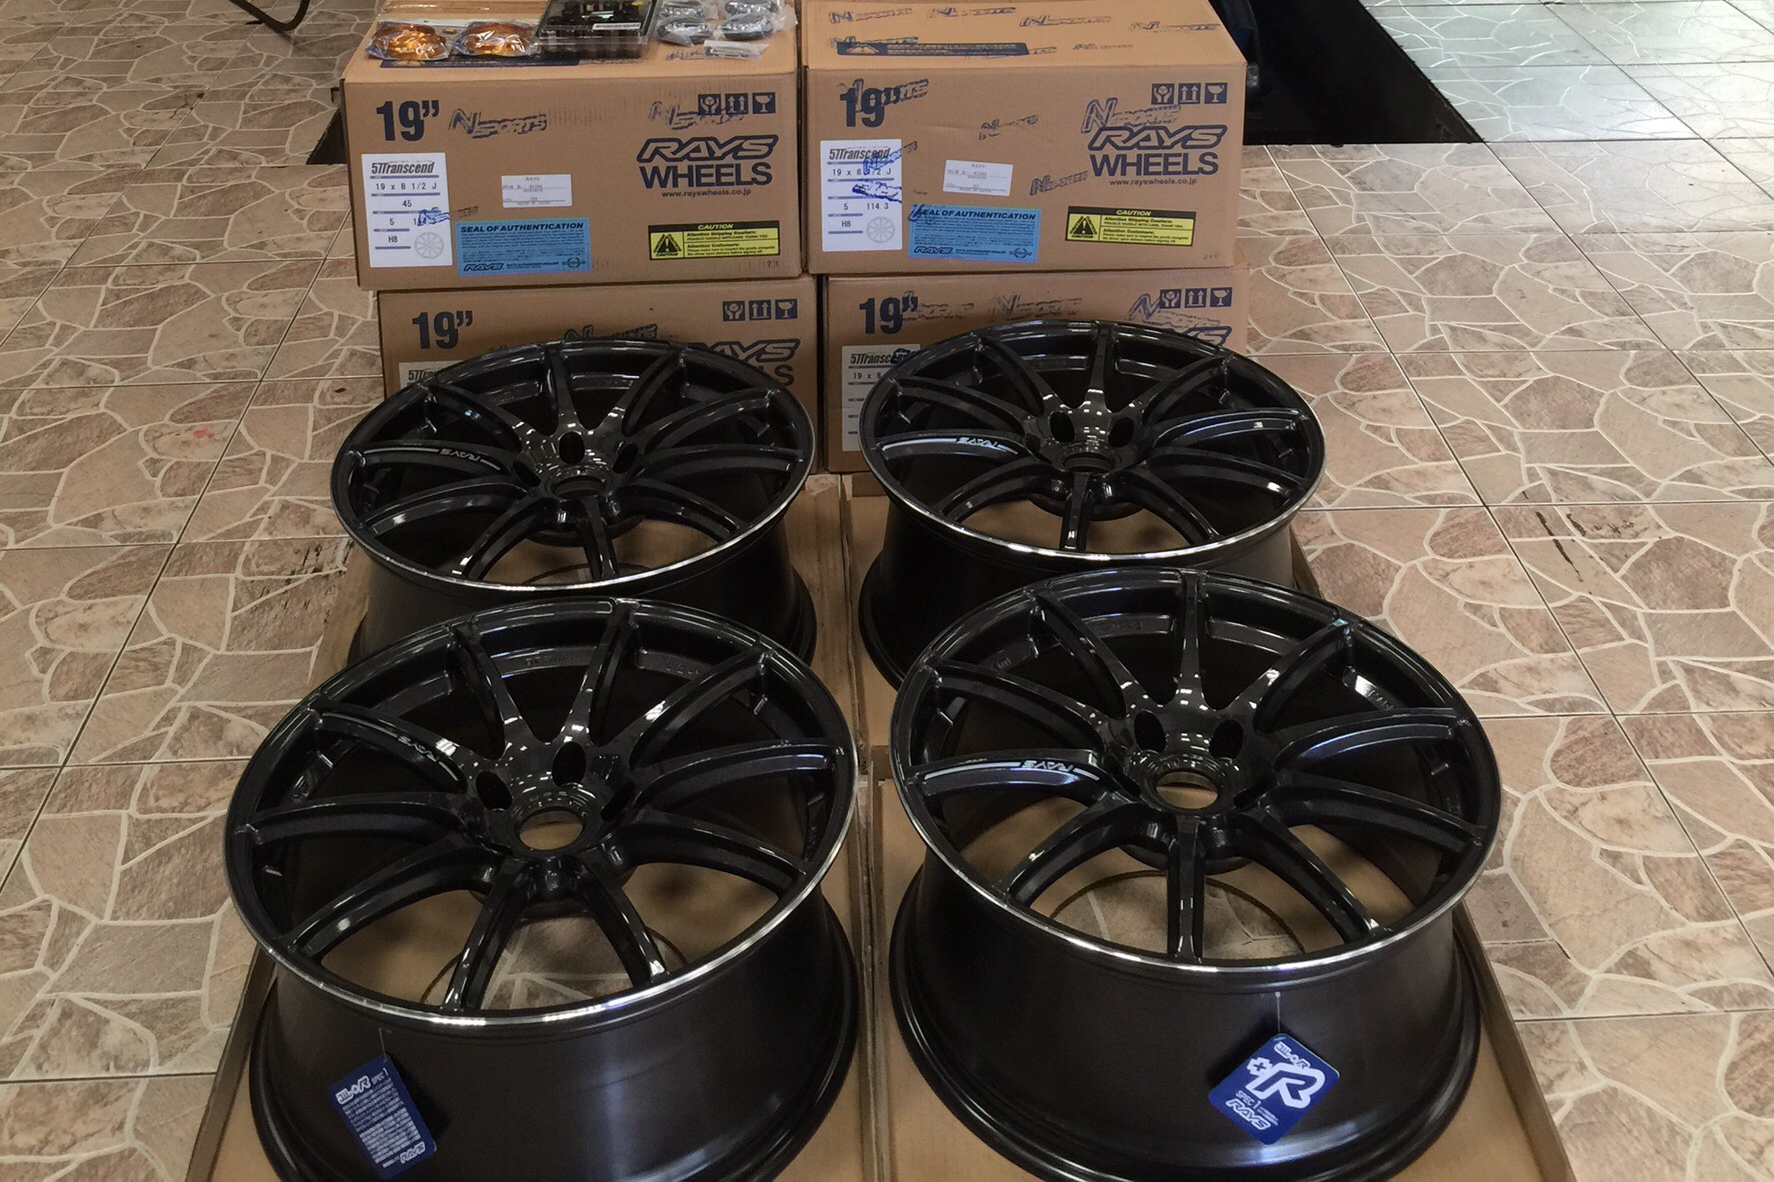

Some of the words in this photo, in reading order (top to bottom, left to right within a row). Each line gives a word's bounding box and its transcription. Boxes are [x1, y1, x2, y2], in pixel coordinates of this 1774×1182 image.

[1087, 124, 1228, 151] RAYS
[636, 134, 779, 163] RAYS
[1089, 151, 1219, 178] WHEELS
[638, 161, 773, 190] WHEELS
[832, 168, 842, 176] 19
[856, 168, 862, 176] 8
[375, 182, 386, 191] 19
[401, 182, 407, 191] 8
[411, 182, 427, 191] 1/2
[431, 182, 437, 190] J
[1109, 177, 1198, 186] www.rayswheels.co.jp
[661, 187, 752, 198] www.rayswheels.co.jp
[402, 200, 413, 208] 45
[916, 208, 940, 218] SEAL
[942, 209, 957, 218] OF
[955, 210, 1036, 220] AUTHENTICATION
[389, 218, 395, 226] 5
[460, 225, 486, 233] SEAL
[486, 225, 501, 233] OF
[500, 222, 584, 232] AUTHENTICATION
[697, 223, 734, 231] CAUTION
[841, 220, 852, 228] H8
[388, 235, 399, 244] H8
[913, 245, 954, 255] RAYS
[463, 262, 504, 272] RAYS
[703, 338, 800, 364] AYS
[853, 372, 863, 380] 19
[955, 435, 1000, 450] RAYS
[438, 447, 482, 464] RAYS
[1020, 759, 1074, 772] RAYS
[1235, 1089, 1255, 1106] SPEC
[1225, 1097, 1272, 1130] RAYS
[399, 1140, 426, 1164] RAYS
